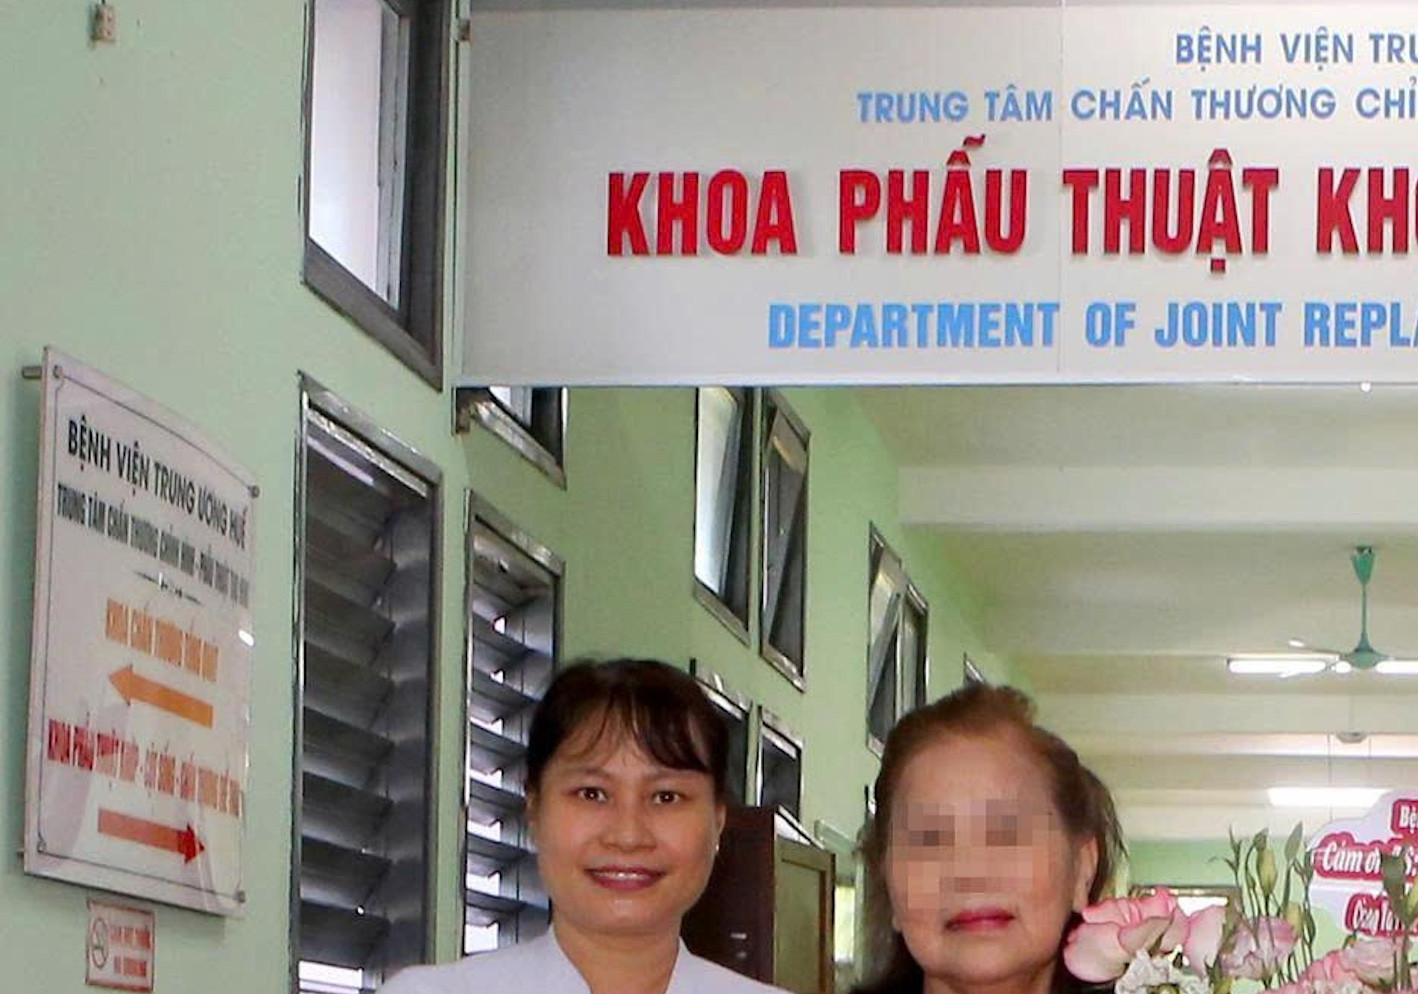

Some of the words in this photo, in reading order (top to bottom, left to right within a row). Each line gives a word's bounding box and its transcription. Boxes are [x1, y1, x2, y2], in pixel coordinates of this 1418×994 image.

[1176, 25, 1262, 71] BỆNH
[1280, 26, 1354, 71] VIỆN
[856, 91, 970, 123] TRUNG
[984, 84, 1053, 122] TÂM
[1070, 78, 1173, 122] CHẤN
[1191, 84, 1337, 121] THƯƠNG
[607, 168, 797, 257] KHOA
[838, 135, 1028, 257] PHẪU
[1061, 149, 1280, 273] THUẬT
[769, 302, 1060, 349] DEPARTMENT
[1086, 302, 1137, 348] OF
[1154, 301, 1282, 348] JOINT
[68, 414, 111, 471] BỆNH
[117, 441, 150, 496] VIỆN
[153, 462, 196, 515] TRUNG
